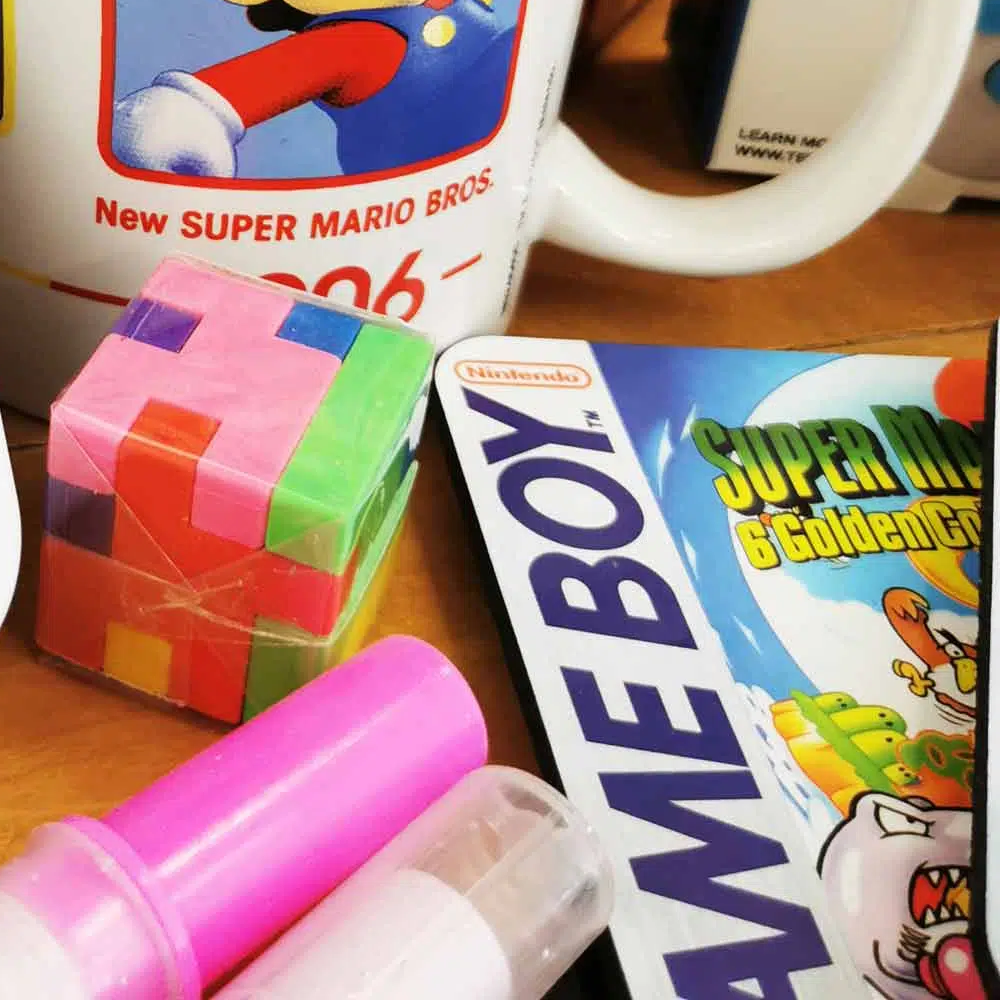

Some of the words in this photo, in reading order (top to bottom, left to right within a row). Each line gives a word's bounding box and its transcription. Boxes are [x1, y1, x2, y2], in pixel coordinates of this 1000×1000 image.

[735, 145, 813, 164] WWW.TE
[738, 127, 796, 146] LEARN
[95, 197, 168, 238] New
[181, 210, 297, 241] SUPER
[310, 197, 416, 239] MARIO
[425, 167, 494, 217] BROS.
[466, 366, 580, 384] Nintendo
[690, 417, 906, 515] SUPER
[461, 386, 699, 651] BOY
[735, 519, 781, 570] 6
[773, 504, 937, 563] Golden
